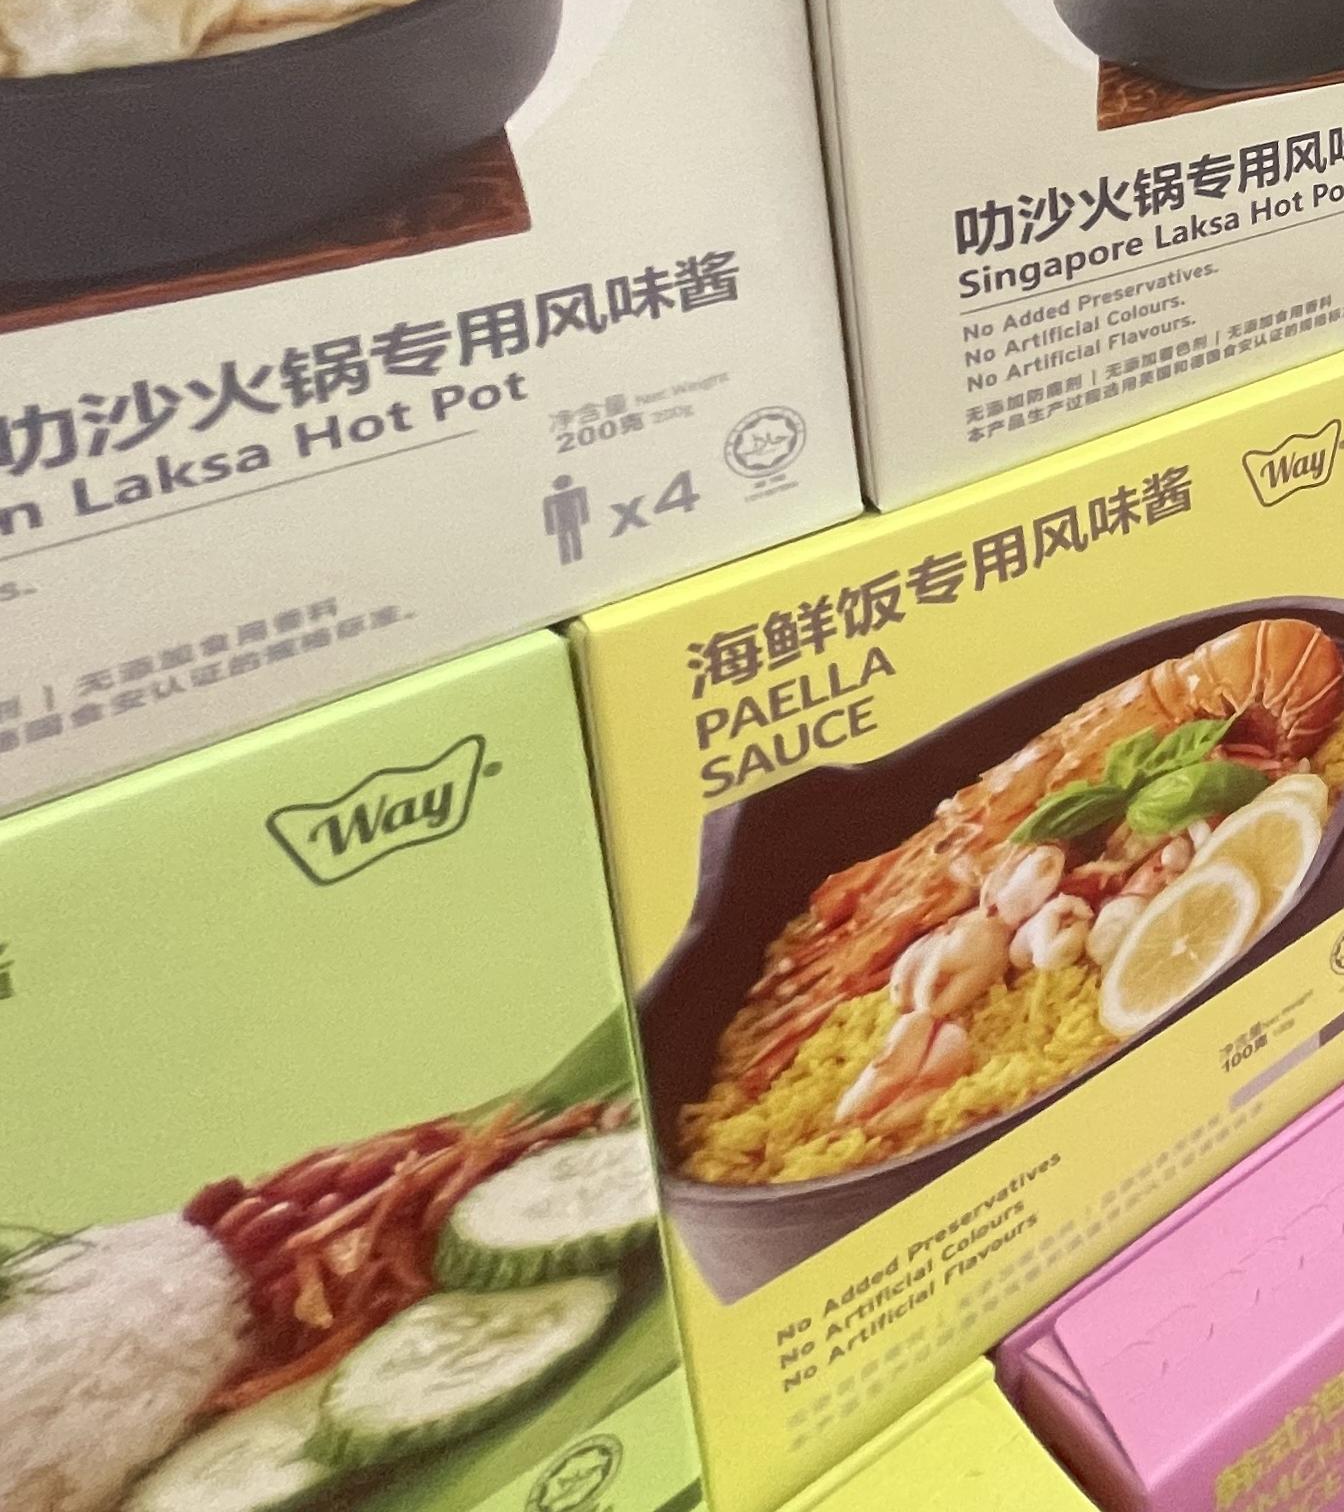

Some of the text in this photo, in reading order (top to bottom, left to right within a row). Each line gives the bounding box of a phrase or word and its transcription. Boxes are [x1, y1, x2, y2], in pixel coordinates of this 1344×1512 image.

[957, 223, 1145, 300] Singapore
[1154, 208, 1242, 250] Laksa
[1250, 192, 1306, 226] Hot
[962, 260, 1220, 343] No Added Preservatives.
[965, 294, 1187, 368] No Artificial Colours.
[967, 315, 1197, 393] No Artificial Flavours.
[72, 438, 272, 520] Laksa
[294, 398, 415, 458] Hot
[431, 372, 529, 423] Pot
[556, 410, 646, 455] 200克
[1258, 446, 1329, 491] Way
[609, 469, 701, 539] x4
[685, 464, 1195, 701] 海鲜饭专用风味酱
[695, 646, 897, 752] PAELLA
[700, 696, 878, 800] SAUCE
[306, 779, 455, 856] Way
[777, 1316, 813, 1347] No
[823, 1255, 899, 1318] Added
[906, 1152, 1062, 1263] Preservatives
[779, 1199, 1025, 1371] No Artificial Colours
[783, 1213, 1039, 1394] No Artificial Flavours
